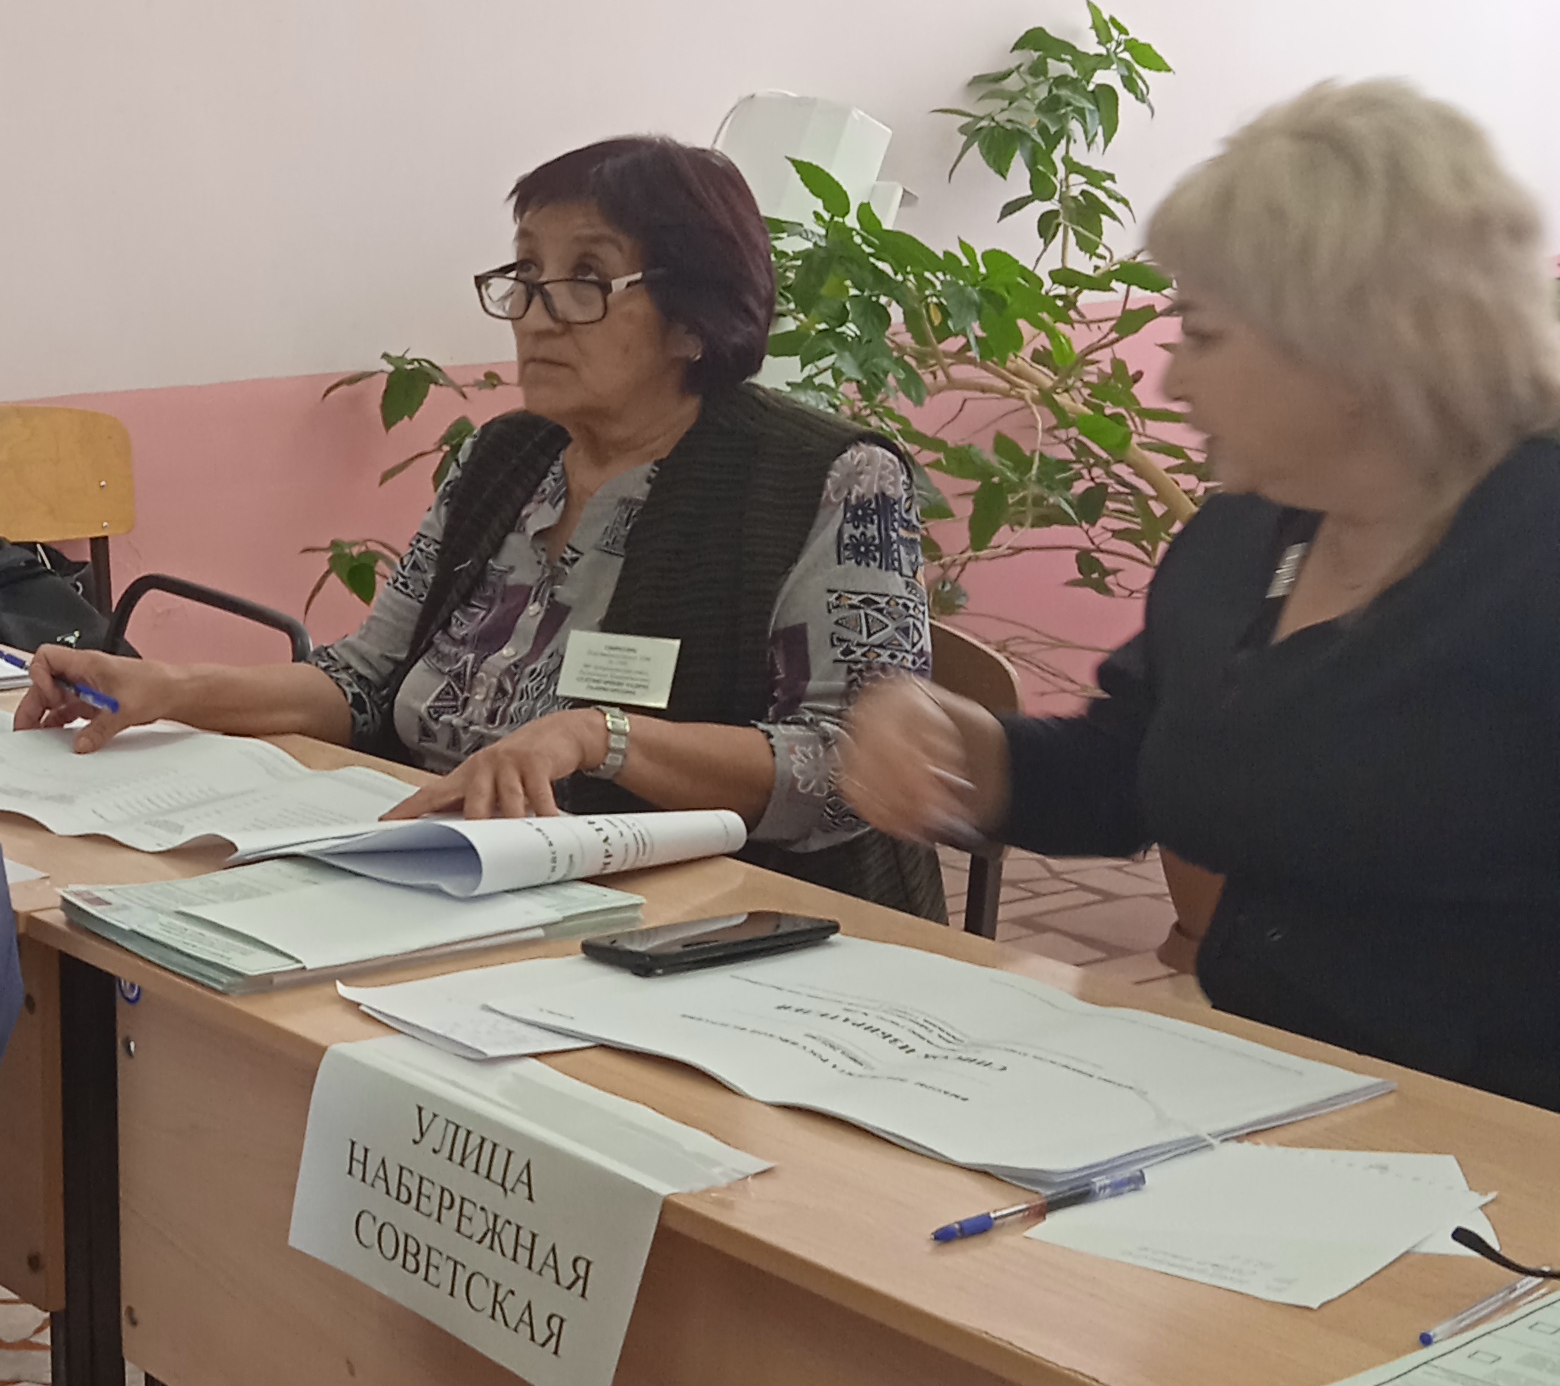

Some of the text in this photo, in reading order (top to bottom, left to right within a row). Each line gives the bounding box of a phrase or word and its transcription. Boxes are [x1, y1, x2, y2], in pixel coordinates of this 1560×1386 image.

[346, 1138, 594, 1301] НАБЕРЕЖНАЯ
[412, 1104, 536, 1204] УЛИЦА
[354, 1208, 568, 1359] СОВЕТСКАЯ
